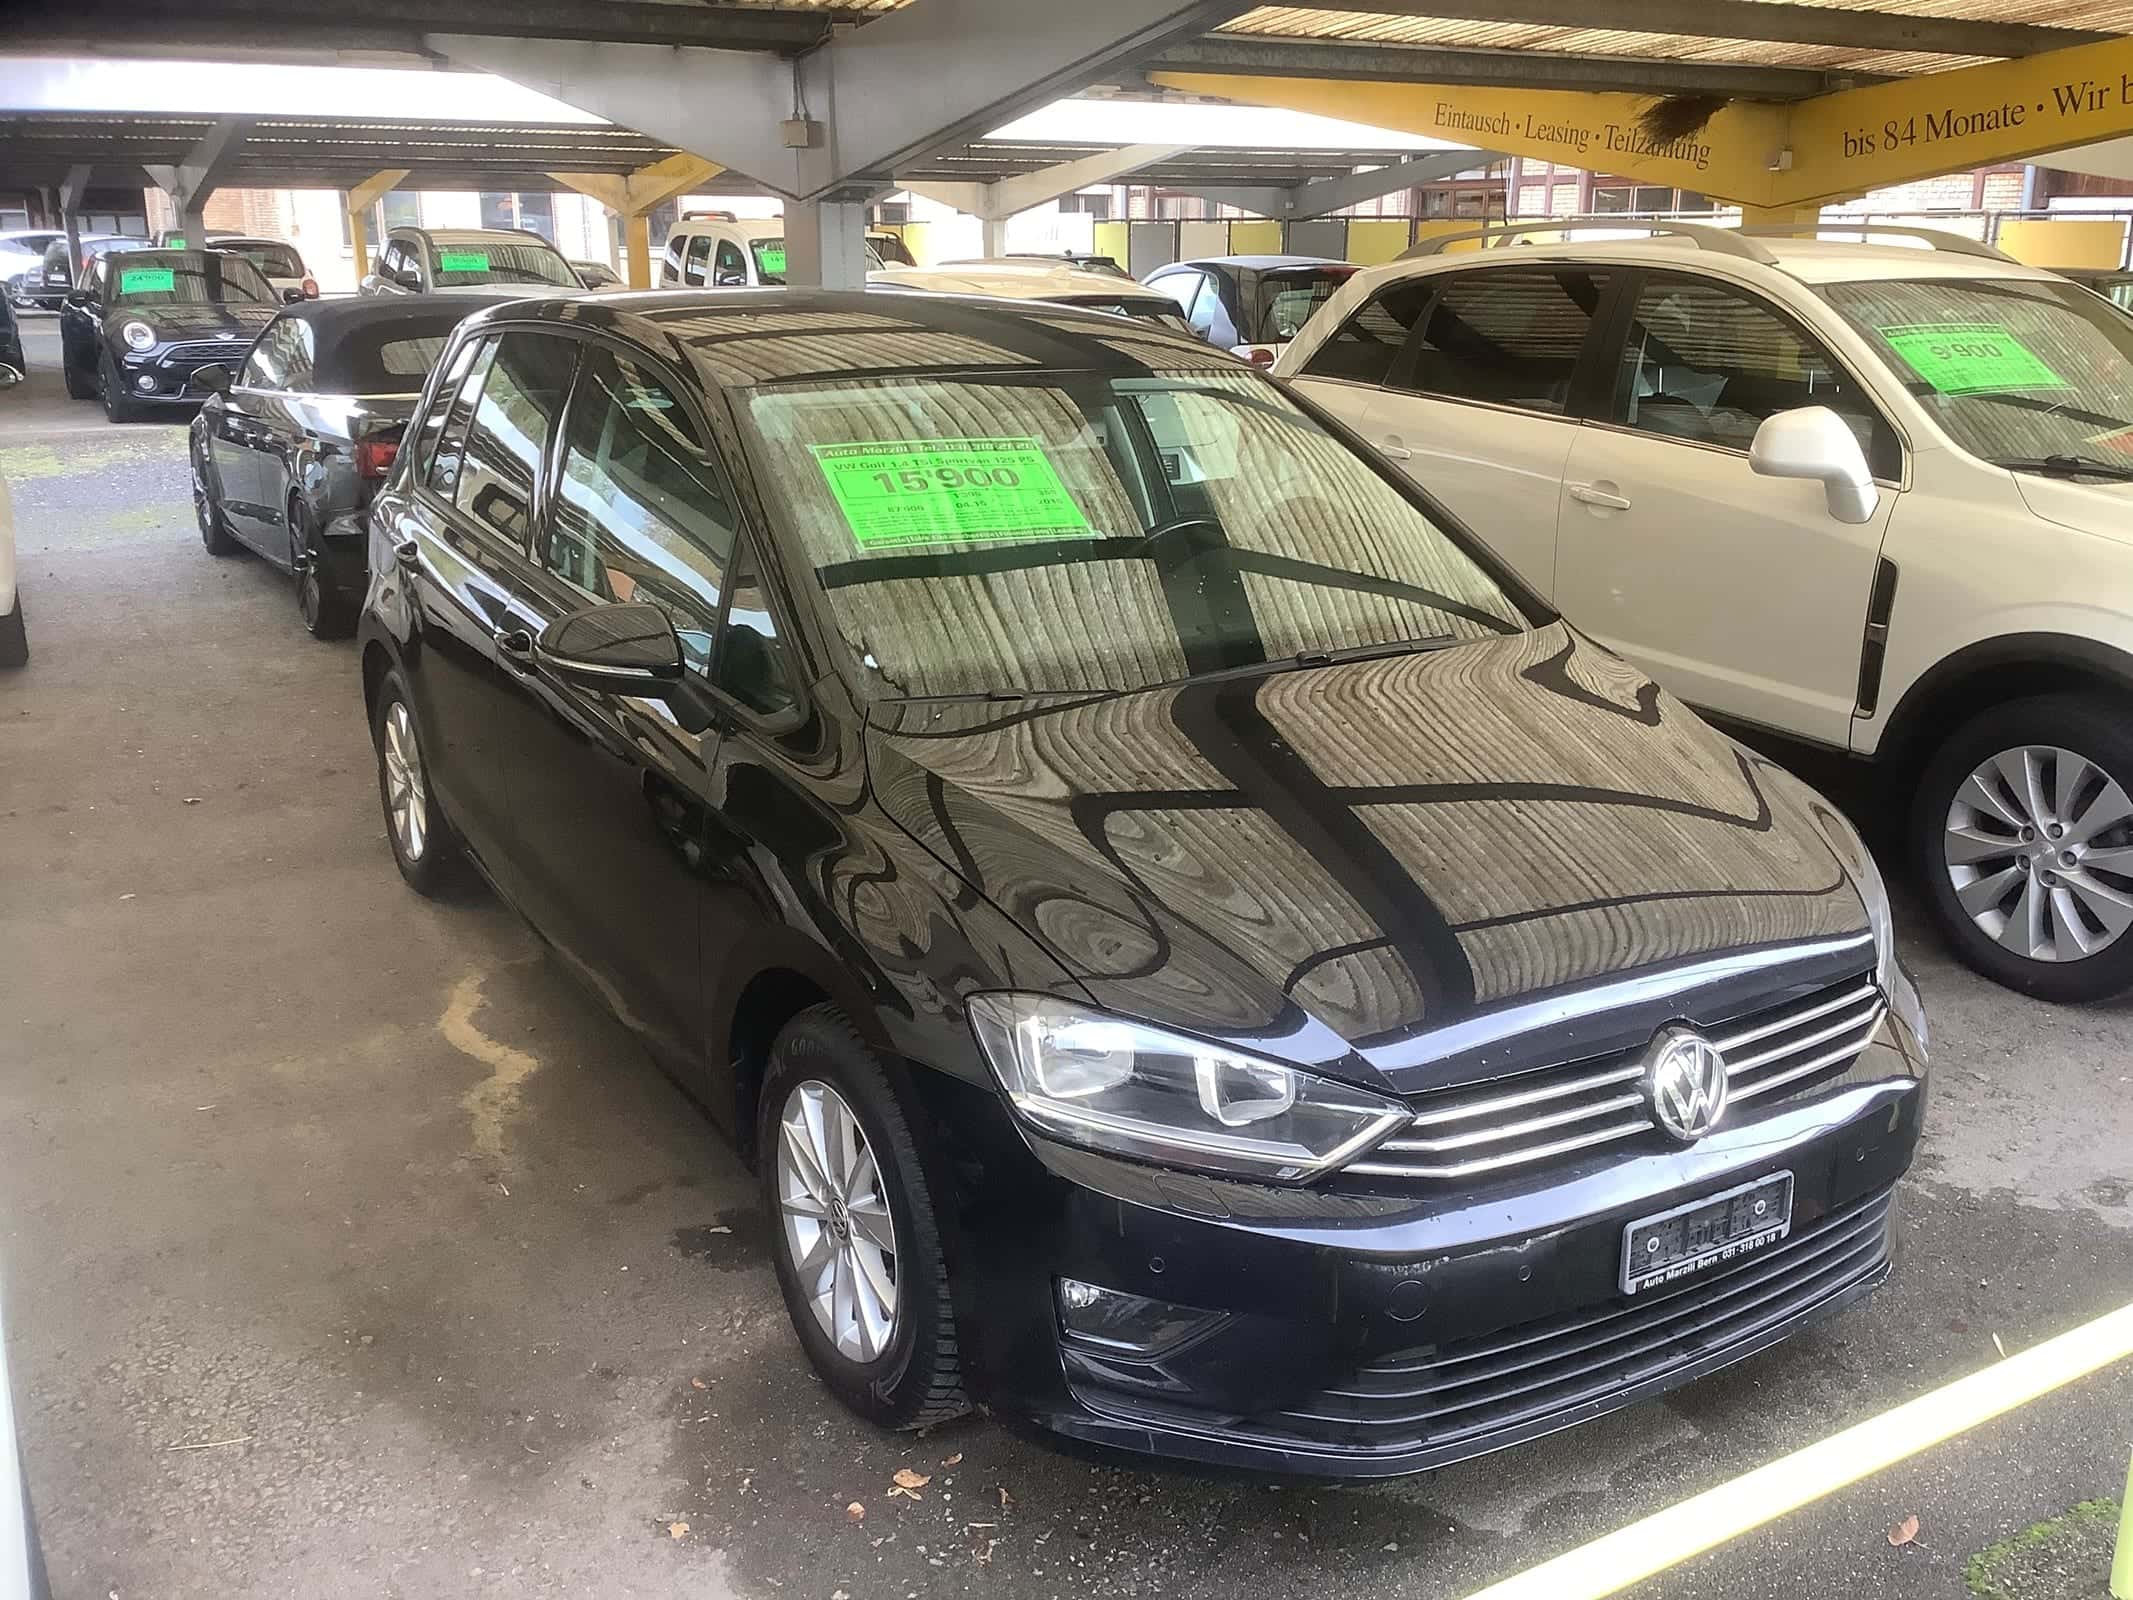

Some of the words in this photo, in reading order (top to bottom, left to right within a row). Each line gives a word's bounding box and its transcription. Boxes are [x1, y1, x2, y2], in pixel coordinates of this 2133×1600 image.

[1434, 102, 1511, 136] Eintausch
[1523, 115, 1592, 154] Leasing
[1843, 128, 1875, 159] bis
[1883, 117, 1917, 151] 84
[1925, 103, 2026, 144] Monate
[2052, 80, 2110, 117] Wir
[824, 449, 858, 458] Auto
[833, 462, 856, 471] VW
[872, 467, 1020, 494] 15'900
[1643, 1274, 1665, 1289] Auto
[1697, 1255, 1718, 1270] Bern
[1722, 1248, 1736, 1260] 031
